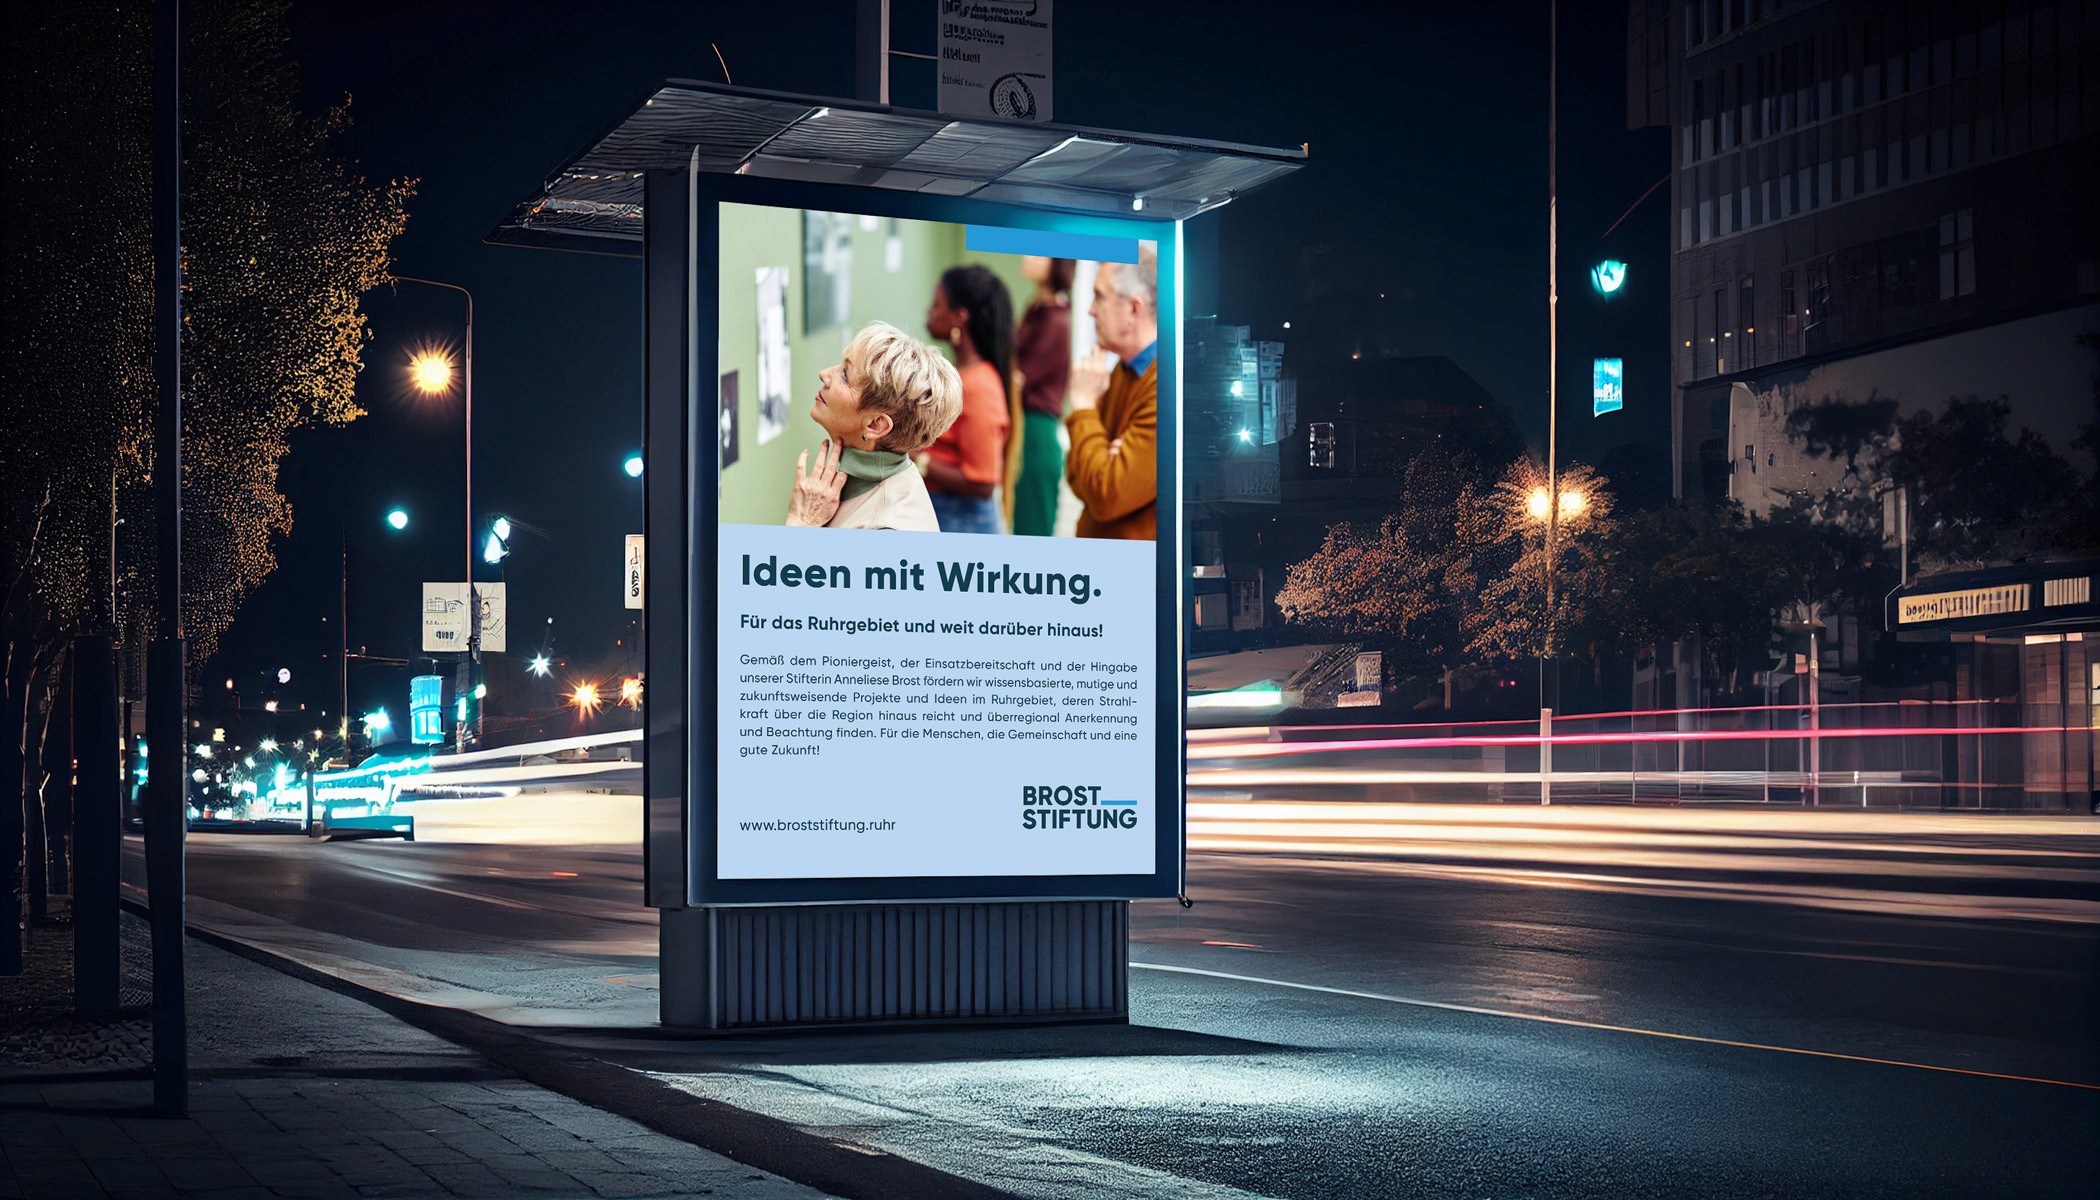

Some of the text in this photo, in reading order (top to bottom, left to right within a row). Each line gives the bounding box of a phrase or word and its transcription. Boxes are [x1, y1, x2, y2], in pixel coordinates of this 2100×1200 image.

[742, 554, 1101, 605] Ideen mit Wirkung.
[741, 614, 1103, 638] Für das Ruhrgebiet und weit darüber hinaus!
[740, 654, 1138, 675] Gemäß dem Pioniergeist, der Einsatzbereitschaft und der Hingabe
[740, 673, 1137, 692] unserer Stifterin Anneliese Brost fördern wir wissensbasierte, mutige und
[740, 690, 1137, 707] zukunftsweisende Projekte und Ideen im Ruhrgebiet, deren Strahl-
[740, 708, 1137, 726] kraft über die Region hinaus reicht und überregional Anerkennung
[740, 726, 1138, 741] und Beachtung finden. Für die Menschen, die Gemeinschaft und eine
[739, 744, 820, 758] gute Zukunft!
[1023, 785, 1102, 806] BROST
[739, 818, 896, 834] www.broststiftung.ruhr
[1022, 808, 1138, 830] STIFTUNG
